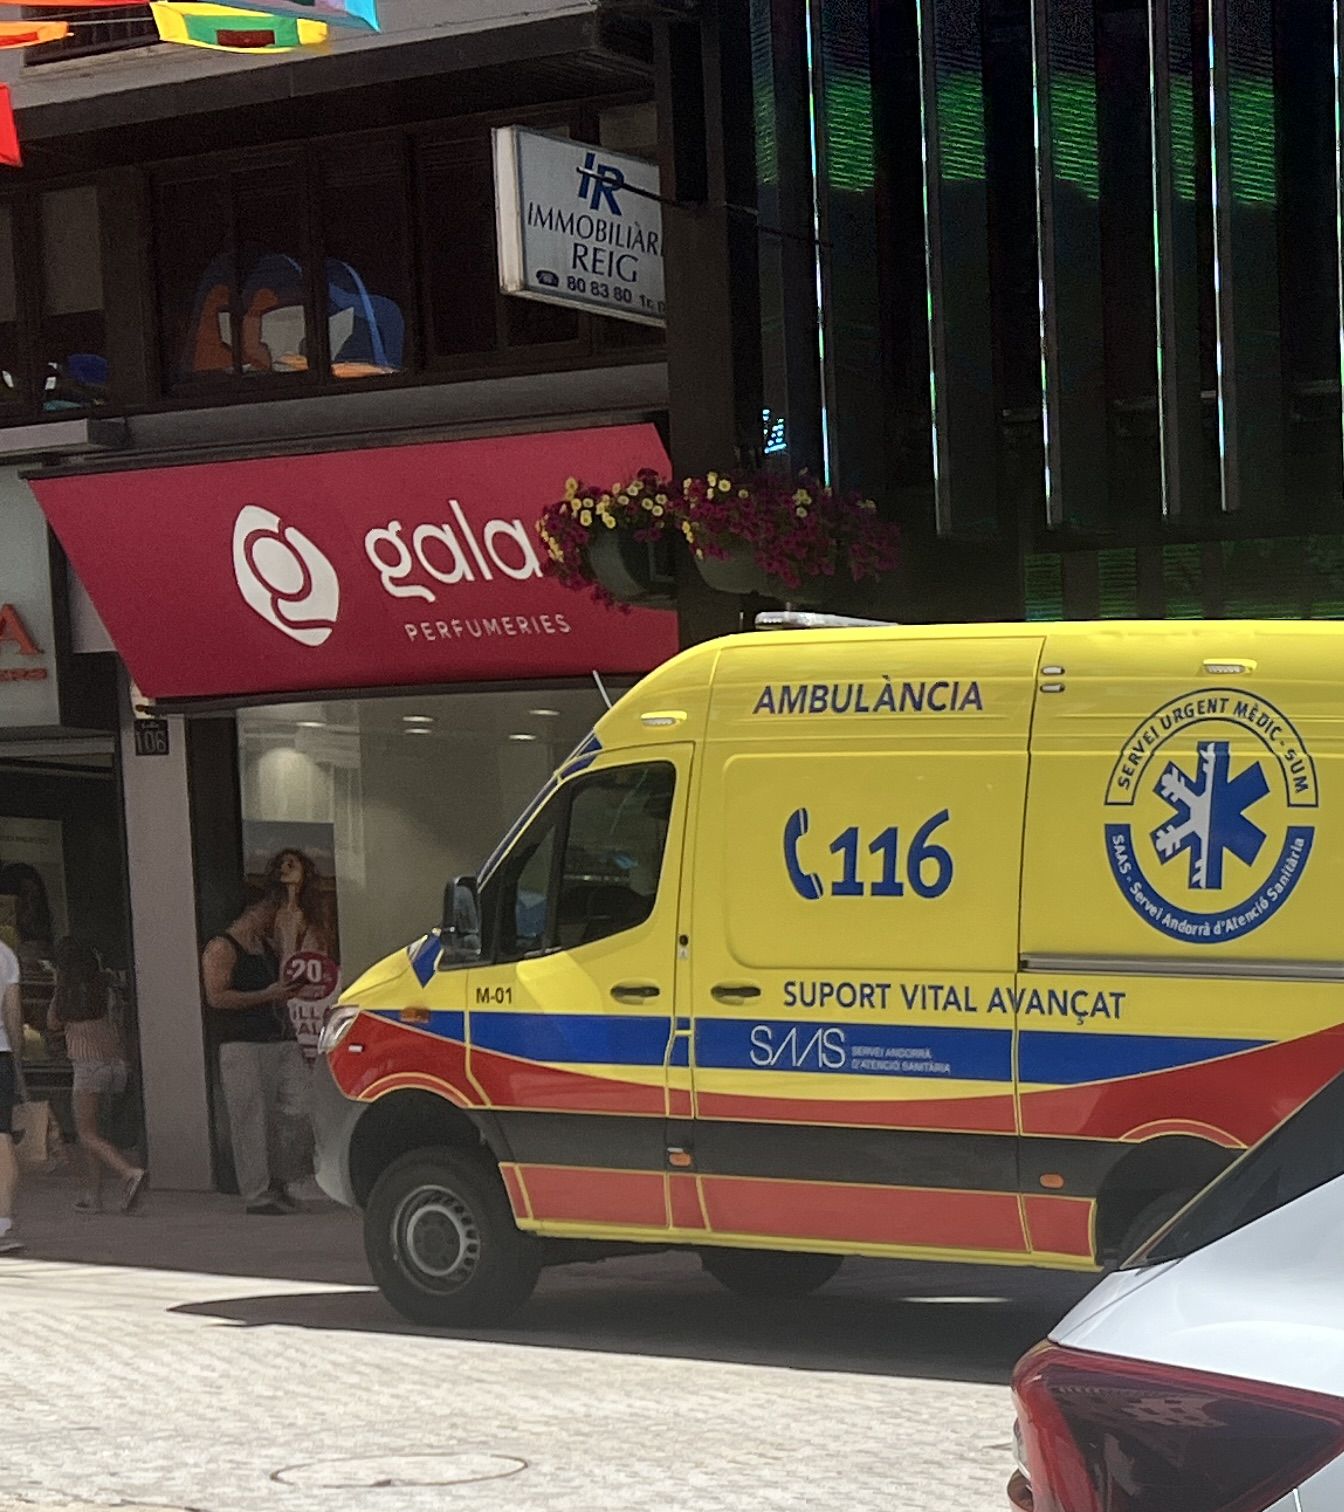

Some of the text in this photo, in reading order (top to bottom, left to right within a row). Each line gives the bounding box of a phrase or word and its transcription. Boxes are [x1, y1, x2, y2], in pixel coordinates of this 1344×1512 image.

[527, 202, 663, 257] IMMOBILIÀR
[572, 242, 638, 282] REIG
[566, 276, 586, 292] 80
[590, 281, 609, 298] 83
[613, 285, 633, 302] 80
[364, 499, 544, 603] gala
[0, 603, 45, 656] A
[404, 613, 572, 642] PERFUMERIES
[752, 674, 984, 715] AMBULÀNCIA
[1117, 726, 1160, 791] SERVEI
[1159, 697, 1230, 731] URGENT
[1284, 748, 1309, 794] SUM
[829, 808, 954, 898] 116
[1112, 833, 1132, 875] SAAS
[1129, 881, 1163, 921] Servei
[1161, 913, 1211, 936] Andorrà
[476, 987, 512, 1004] M-01
[783, 981, 1127, 1026] SUPORT VITAL AVANÇAT
